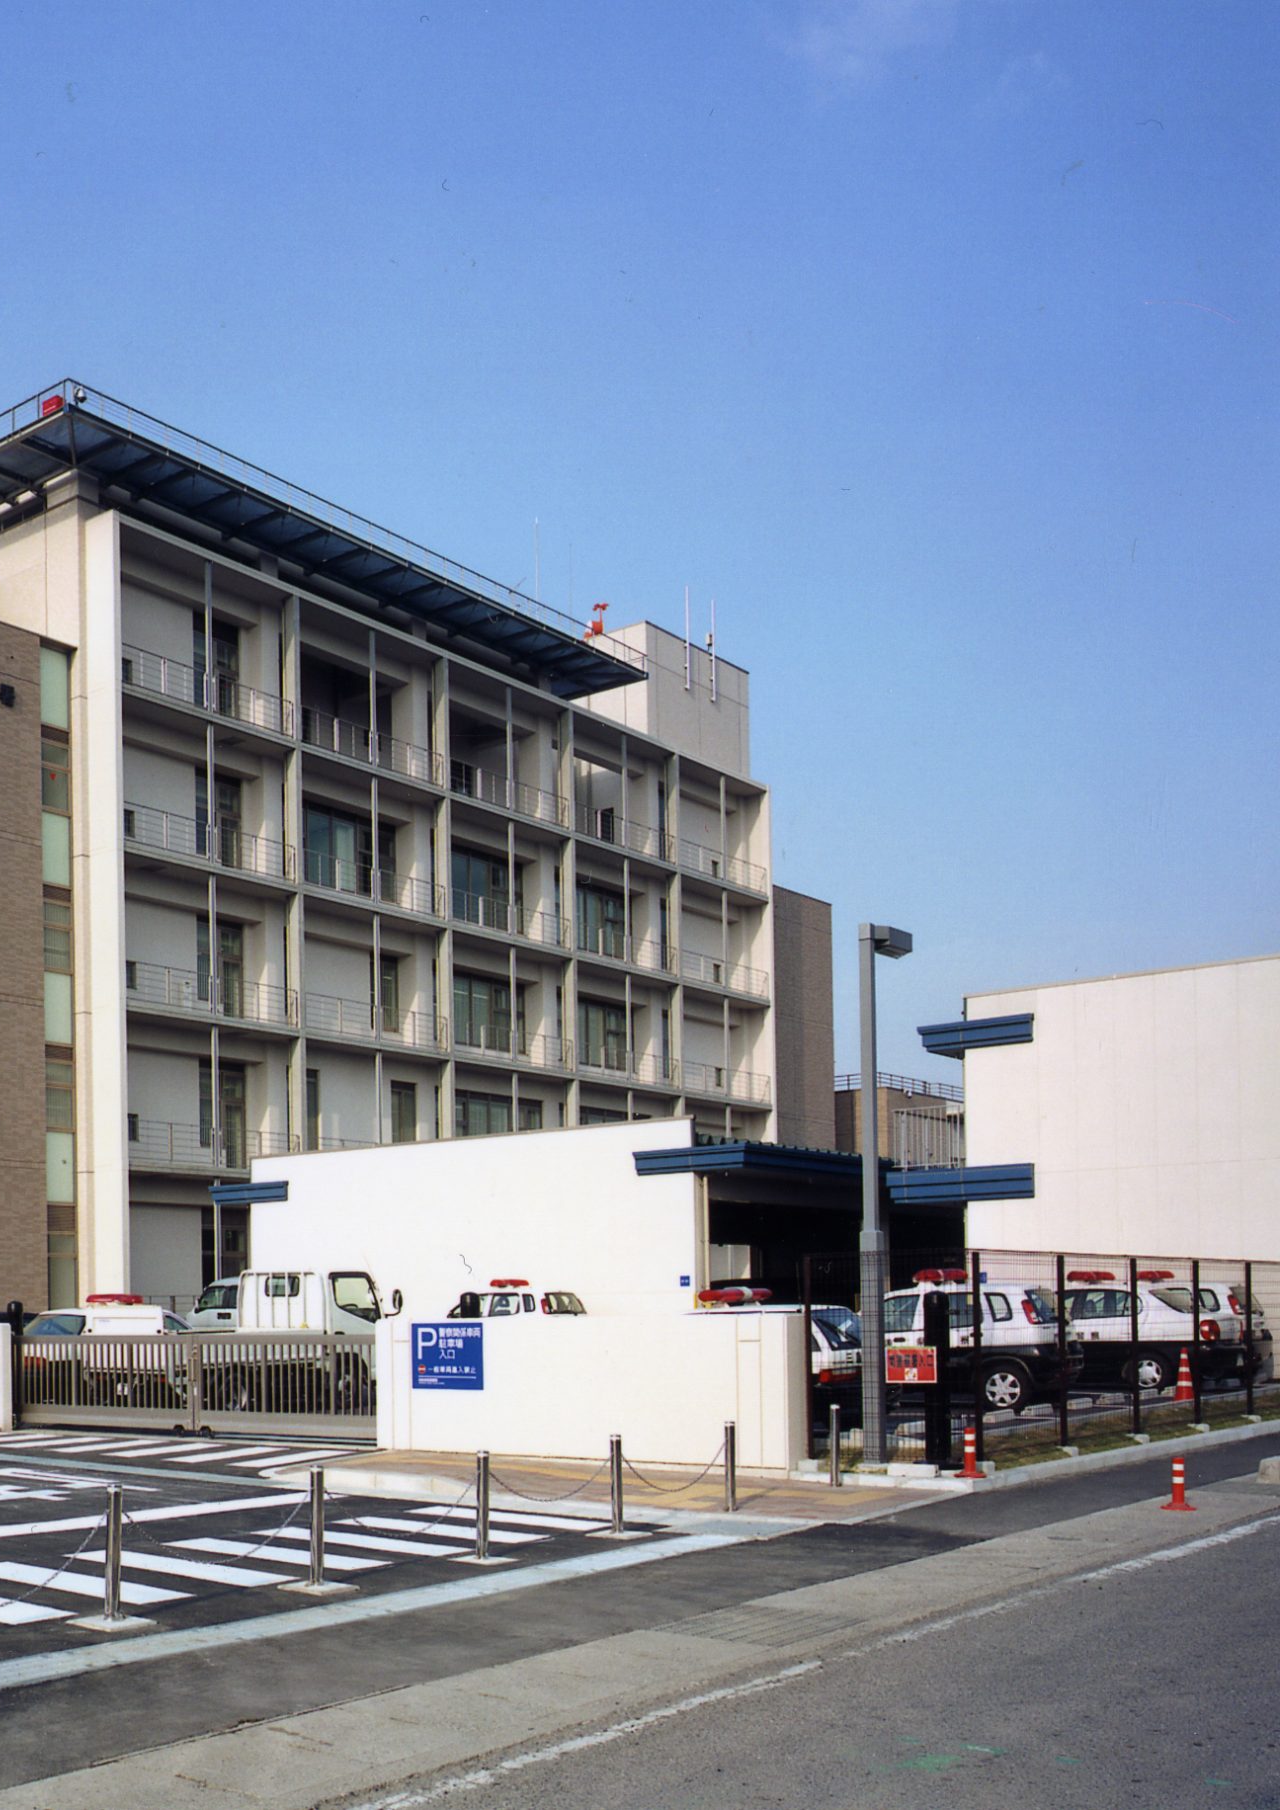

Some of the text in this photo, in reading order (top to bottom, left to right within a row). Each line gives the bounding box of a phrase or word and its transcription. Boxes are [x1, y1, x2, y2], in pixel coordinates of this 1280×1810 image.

[417, 1327, 437, 1360] P
[438, 1338, 463, 1349] 駐車場
[439, 1349, 455, 1359] 入口
